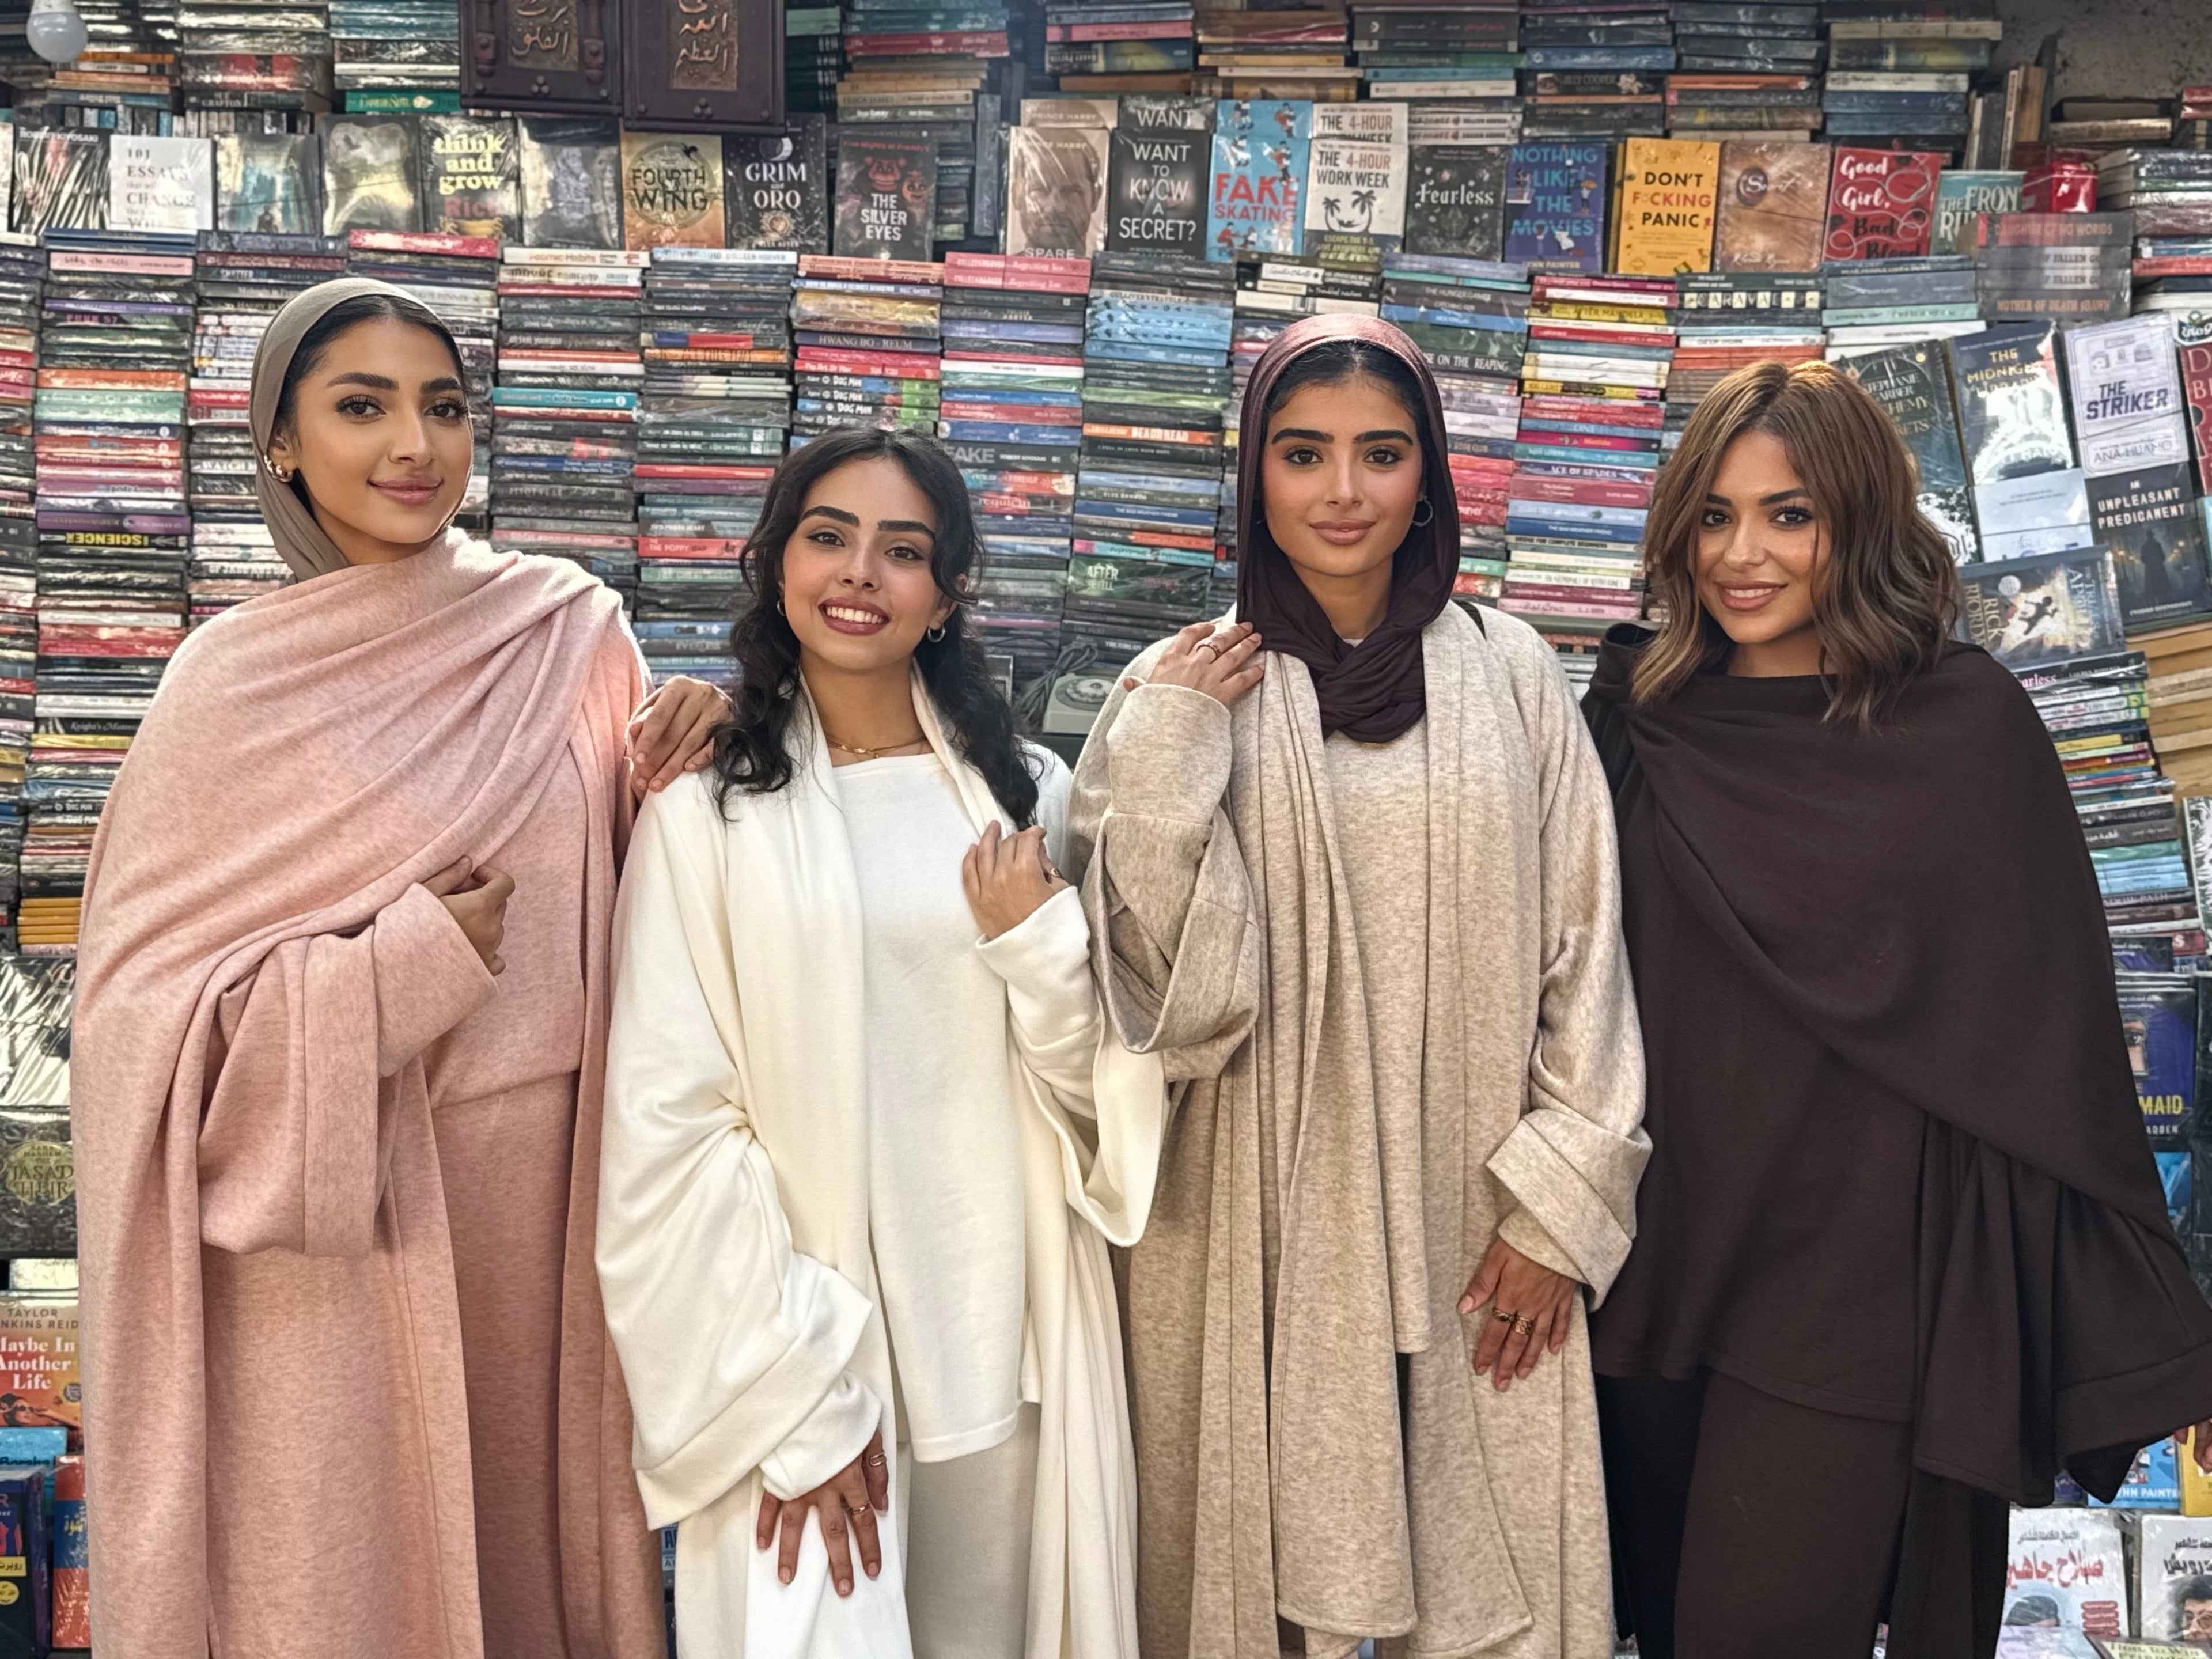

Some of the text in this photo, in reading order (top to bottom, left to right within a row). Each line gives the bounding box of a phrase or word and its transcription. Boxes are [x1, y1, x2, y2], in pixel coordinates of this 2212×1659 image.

[1137, 109, 1194, 127] WANT
[1321, 115, 1393, 131] THE 4-HOUR
[433, 132, 506, 154] think
[127, 147, 150, 160] 101
[1133, 143, 1191, 162] WANT
[1318, 150, 1391, 170] THE 4-HOUR
[1510, 147, 1599, 163] NOTHING
[445, 152, 495, 172] and
[1840, 155, 1888, 180] Good
[632, 168, 706, 186] FOURTH
[745, 162, 807, 183] GRIM
[1152, 165, 1170, 177] TO
[1316, 170, 1389, 188] WORK WEEK
[1644, 171, 1703, 187] DON'T
[438, 175, 505, 195] grow
[1130, 178, 1188, 202] KNOW
[1215, 173, 1300, 206] FAKE
[632, 188, 709, 213] WING
[753, 190, 801, 210] ORO
[871, 193, 897, 209] THE
[1535, 196, 1572, 213] THE
[1632, 191, 1712, 208] FCKING
[1842, 185, 1891, 211] Girl,
[1940, 185, 2022, 212] THE FRON
[860, 209, 907, 226] SILVER
[1152, 203, 1164, 215] A
[1214, 204, 1297, 224] SKATING
[1510, 219, 1594, 236] MOVIES
[1641, 212, 1699, 228] PANIC
[1853, 217, 1895, 237] Bad
[865, 226, 902, 241] EYES
[1119, 217, 1196, 241] SECRET?
[1024, 248, 1076, 259] SPARE
[2052, 254, 2087, 263] FALLEN
[2052, 275, 2086, 285] FALLEN
[819, 335, 858, 347] HWANG
[1437, 353, 1450, 365] ON
[1453, 355, 1470, 368] THE
[1474, 357, 1509, 372] REAPING
[1988, 347, 2018, 363] THE
[2099, 380, 2128, 400] THE
[2086, 387, 2169, 421] STRIKER
[2093, 446, 2122, 463] ANA
[1550, 465, 1617, 479] ACE OF SPADES
[2130, 480, 2141, 490] AN
[2097, 487, 2181, 512] UNPLEASANT
[2097, 503, 2186, 530] PREDICAMENT
[74, 533, 143, 545] SCIENCE
[2021, 672, 2057, 688] arless
[70, 721, 102, 733] Knight's
[2138, 1094, 2183, 1116] MAID
[13, 1165, 74, 1181] JASAD
[7, 1308, 59, 1318] TAYLOR
[48, 1319, 79, 1330] REID
[55, 1336, 76, 1353] In
[12, 1373, 52, 1391] Life
